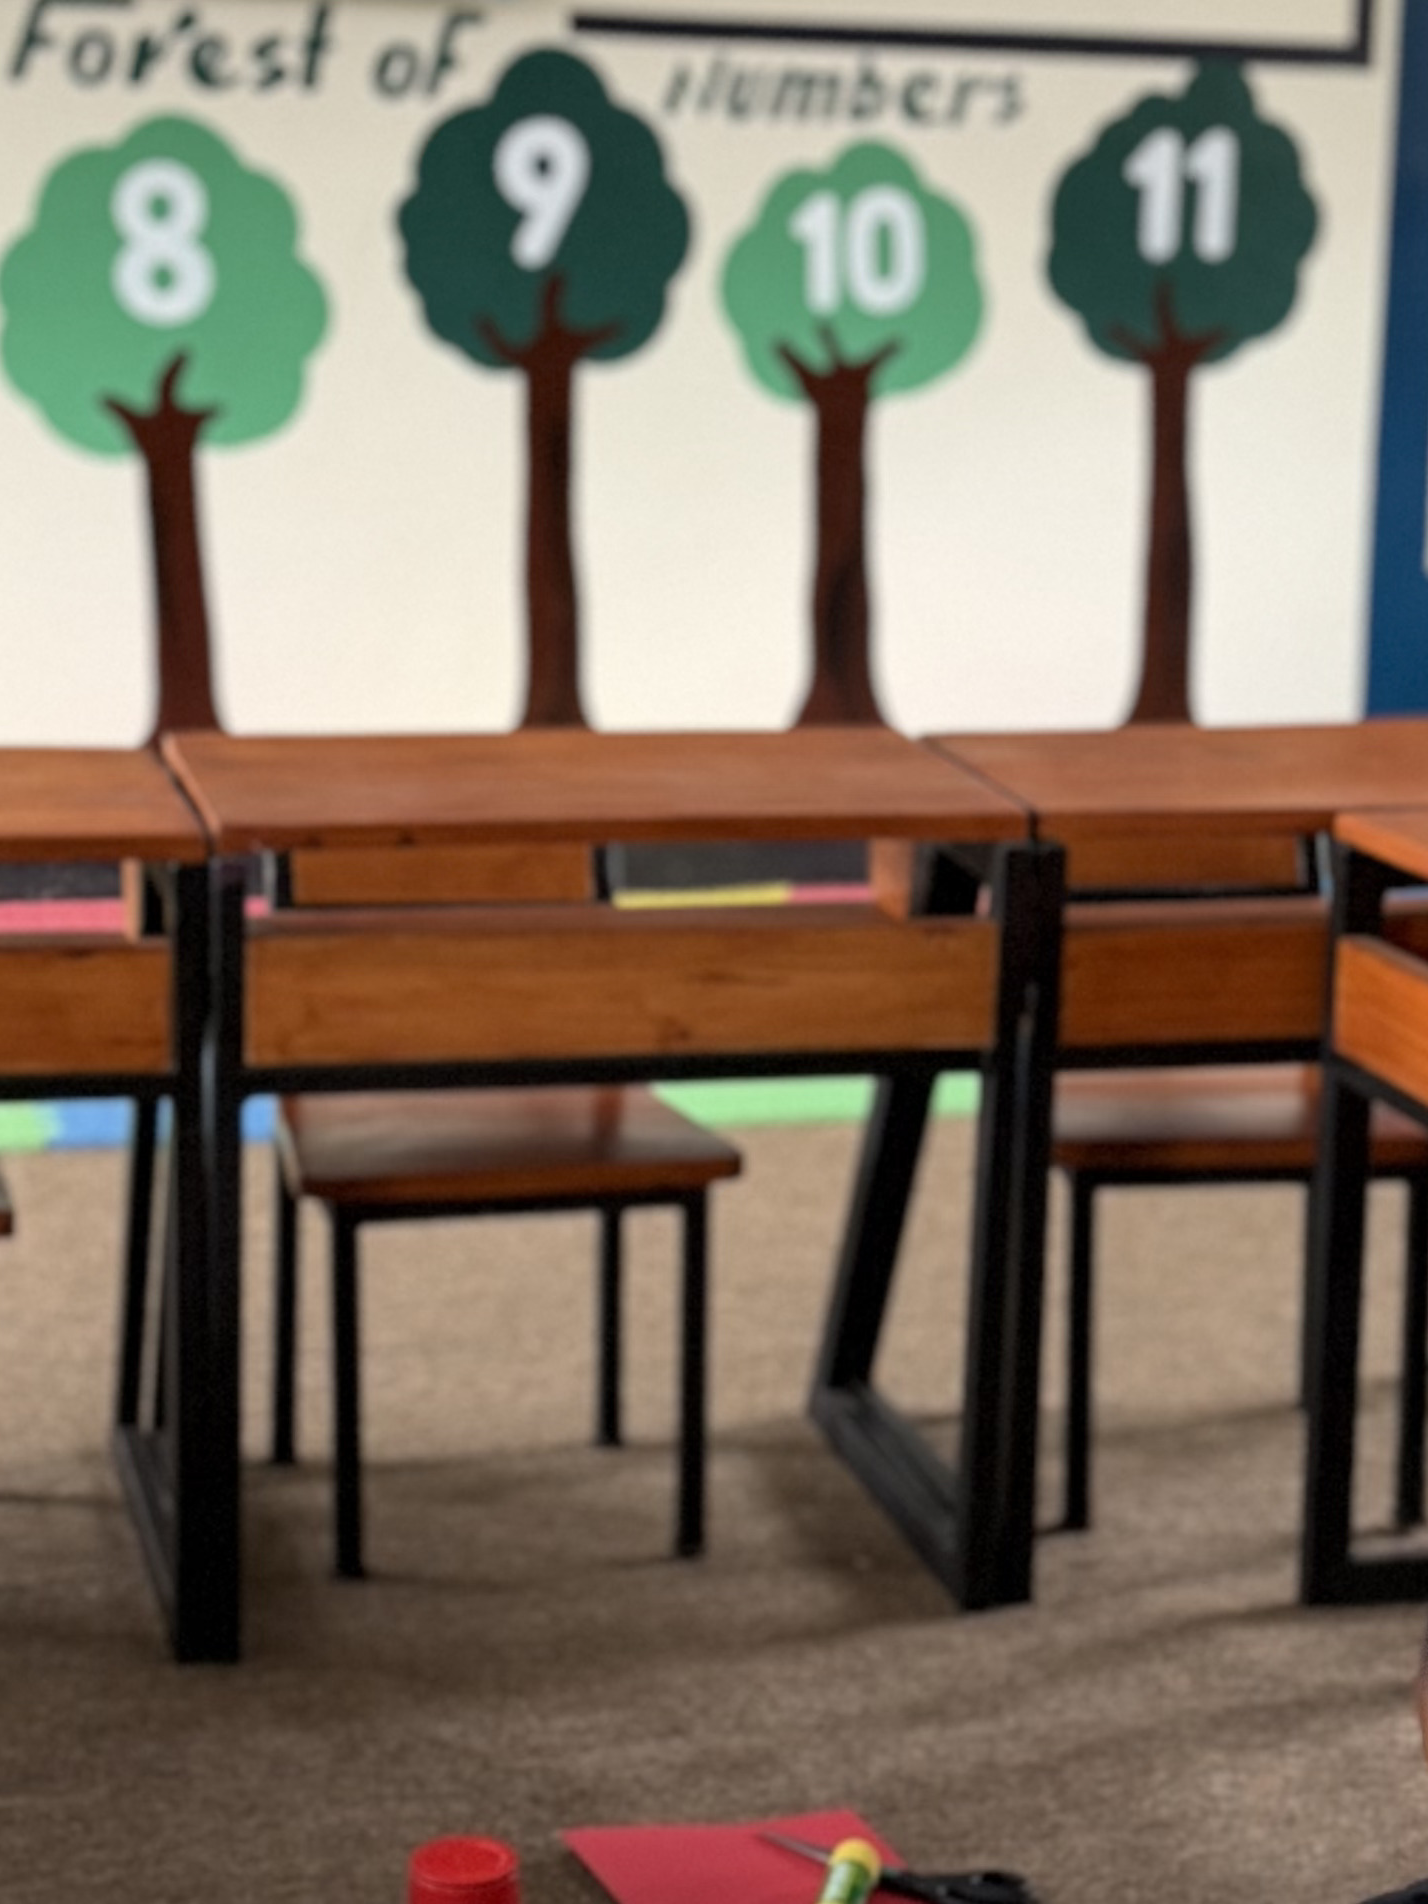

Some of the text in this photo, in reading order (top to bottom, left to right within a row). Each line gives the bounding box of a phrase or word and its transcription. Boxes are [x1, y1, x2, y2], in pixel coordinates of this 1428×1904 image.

[111, 158, 217, 327] 8
[492, 115, 590, 269] 9
[789, 184, 928, 316] 10
[1123, 126, 1240, 264] 11
